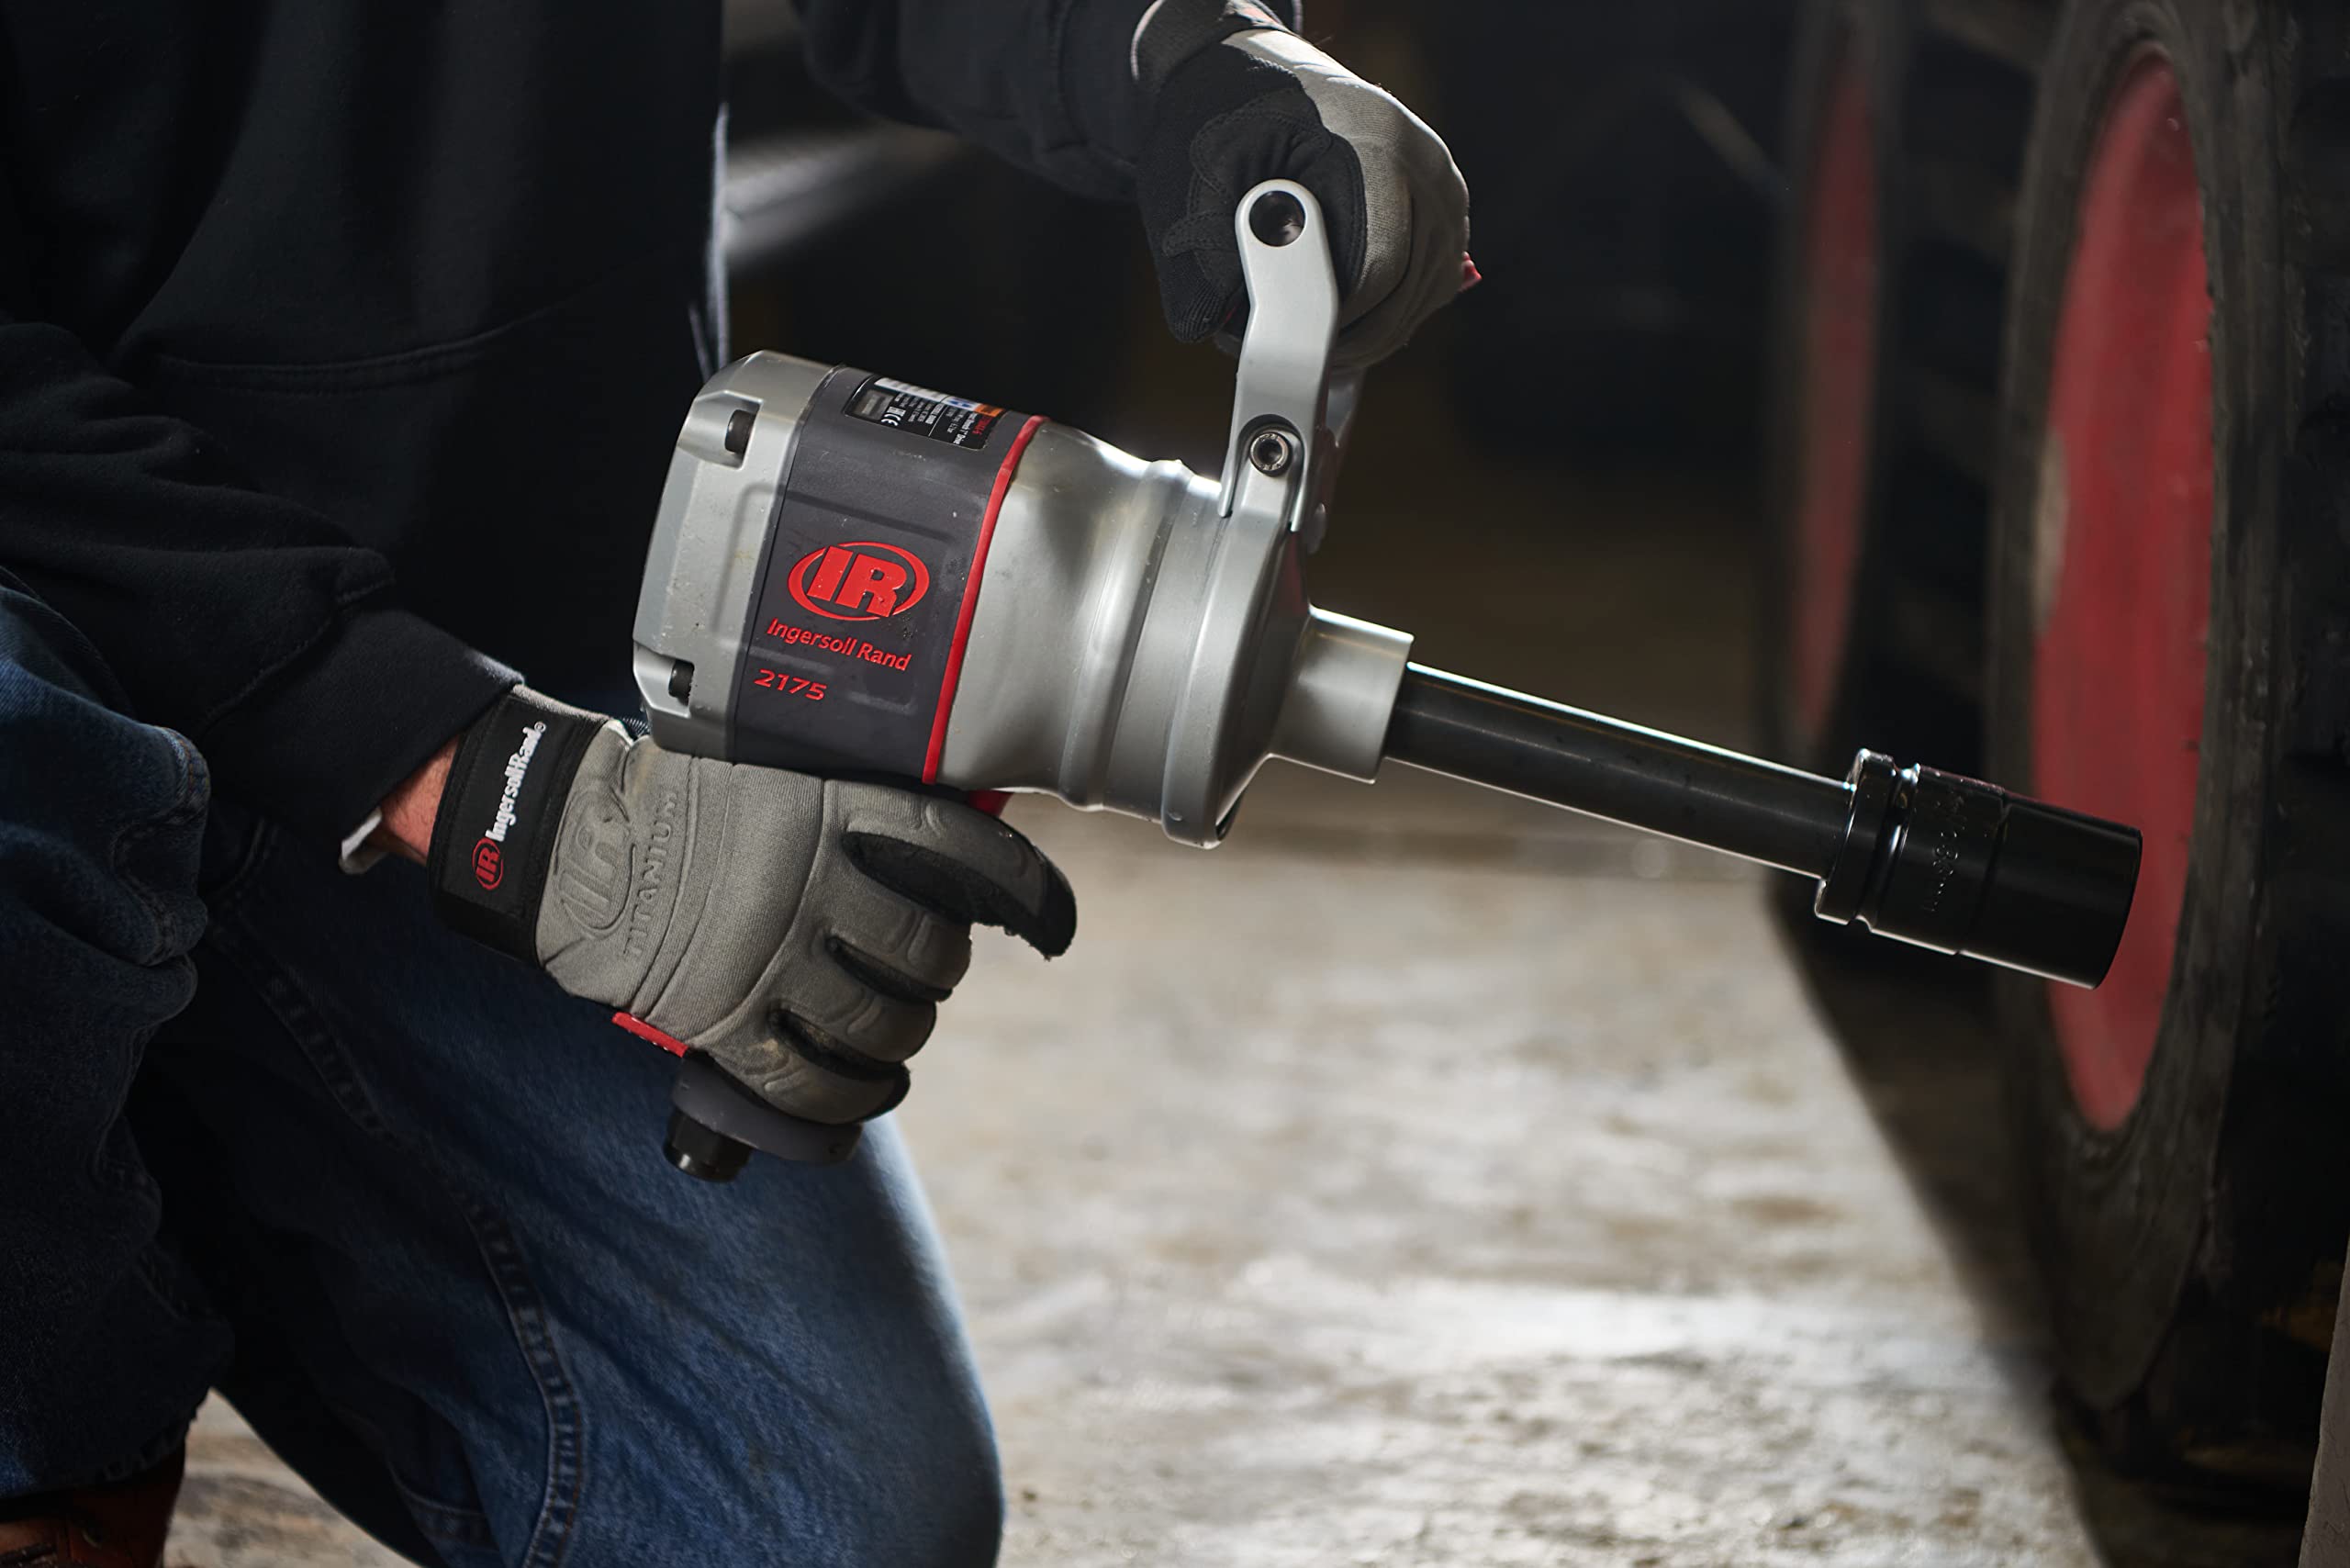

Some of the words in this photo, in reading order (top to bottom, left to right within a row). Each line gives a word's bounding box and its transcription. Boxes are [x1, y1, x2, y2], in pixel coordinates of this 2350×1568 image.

[802, 544, 909, 618] IR
[767, 619, 857, 655] Ingersoll
[856, 643, 912, 671] Rand
[754, 669, 828, 700] 2175
[474, 843, 501, 887] IR
